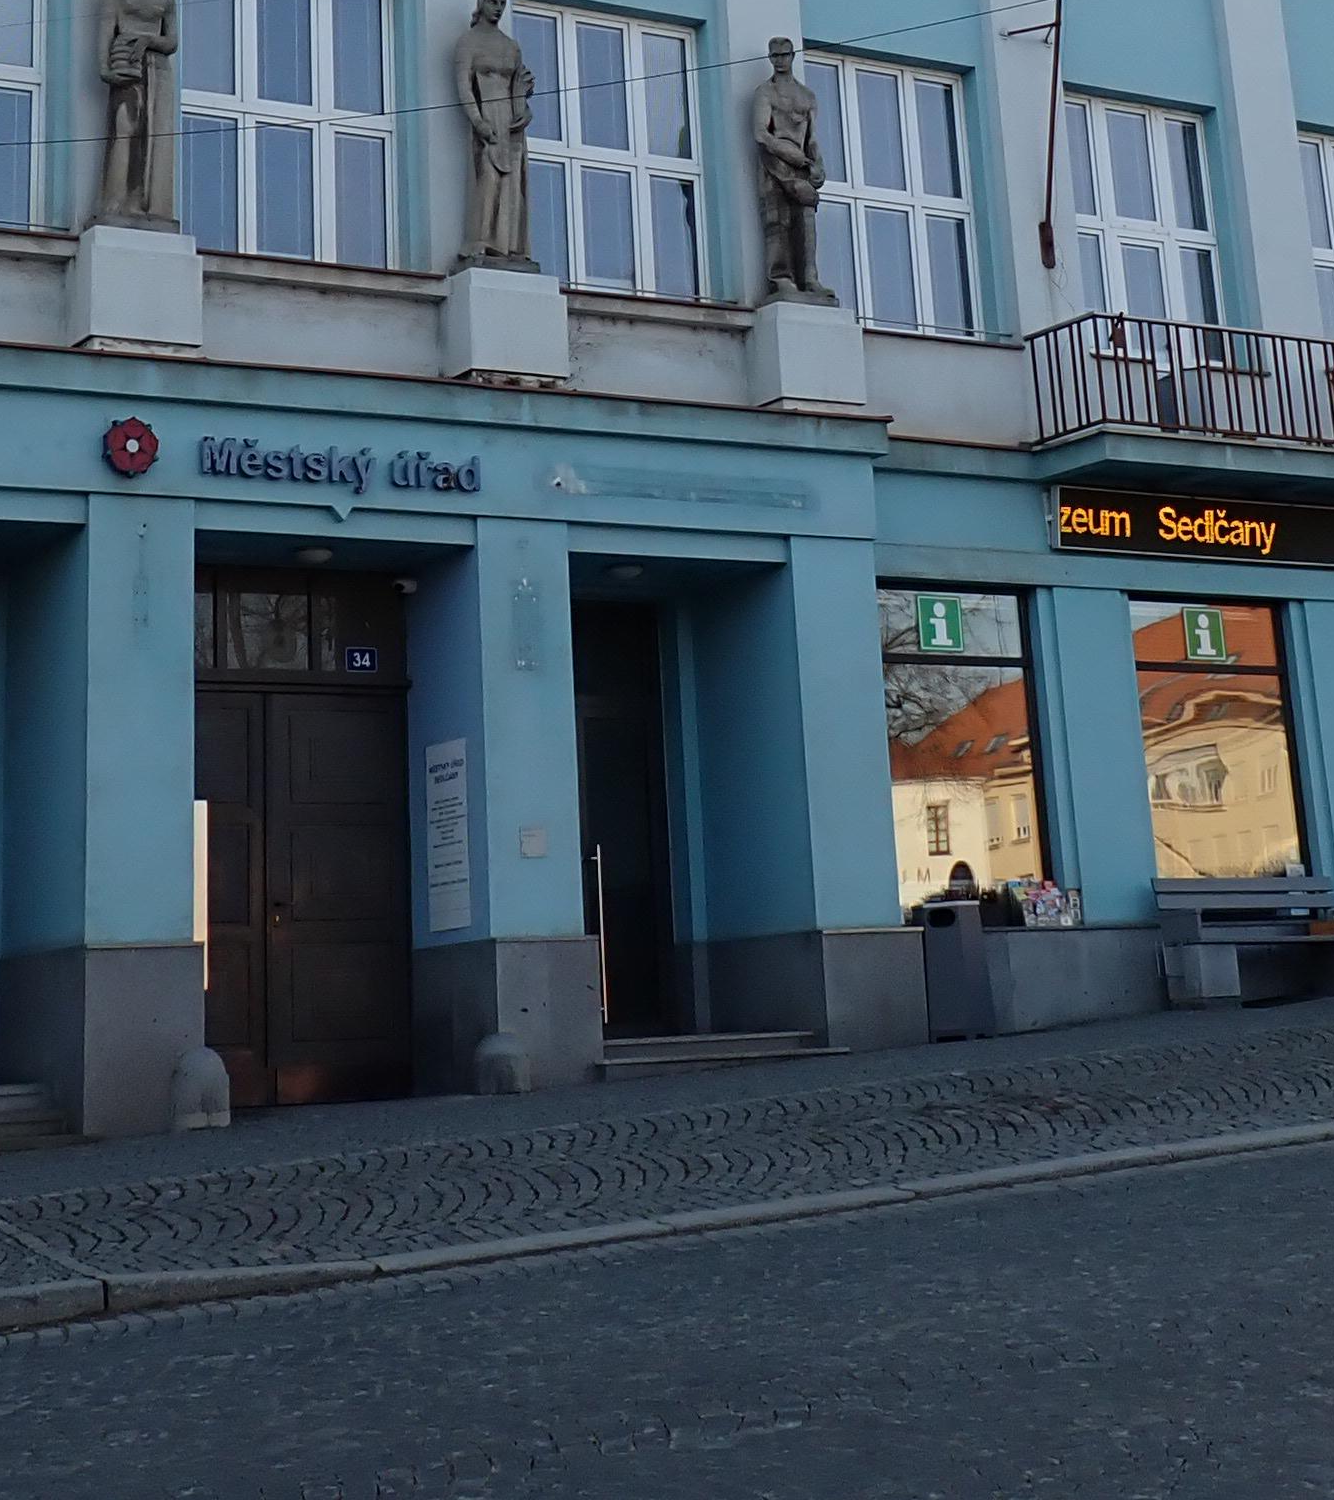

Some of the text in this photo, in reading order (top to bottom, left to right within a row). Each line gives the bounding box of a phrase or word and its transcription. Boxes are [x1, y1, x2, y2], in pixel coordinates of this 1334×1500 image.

[200, 436, 482, 494] Městský úřad
[1060, 506, 1276, 555] zeum Sedlčany
[352, 652, 371, 668] 34
